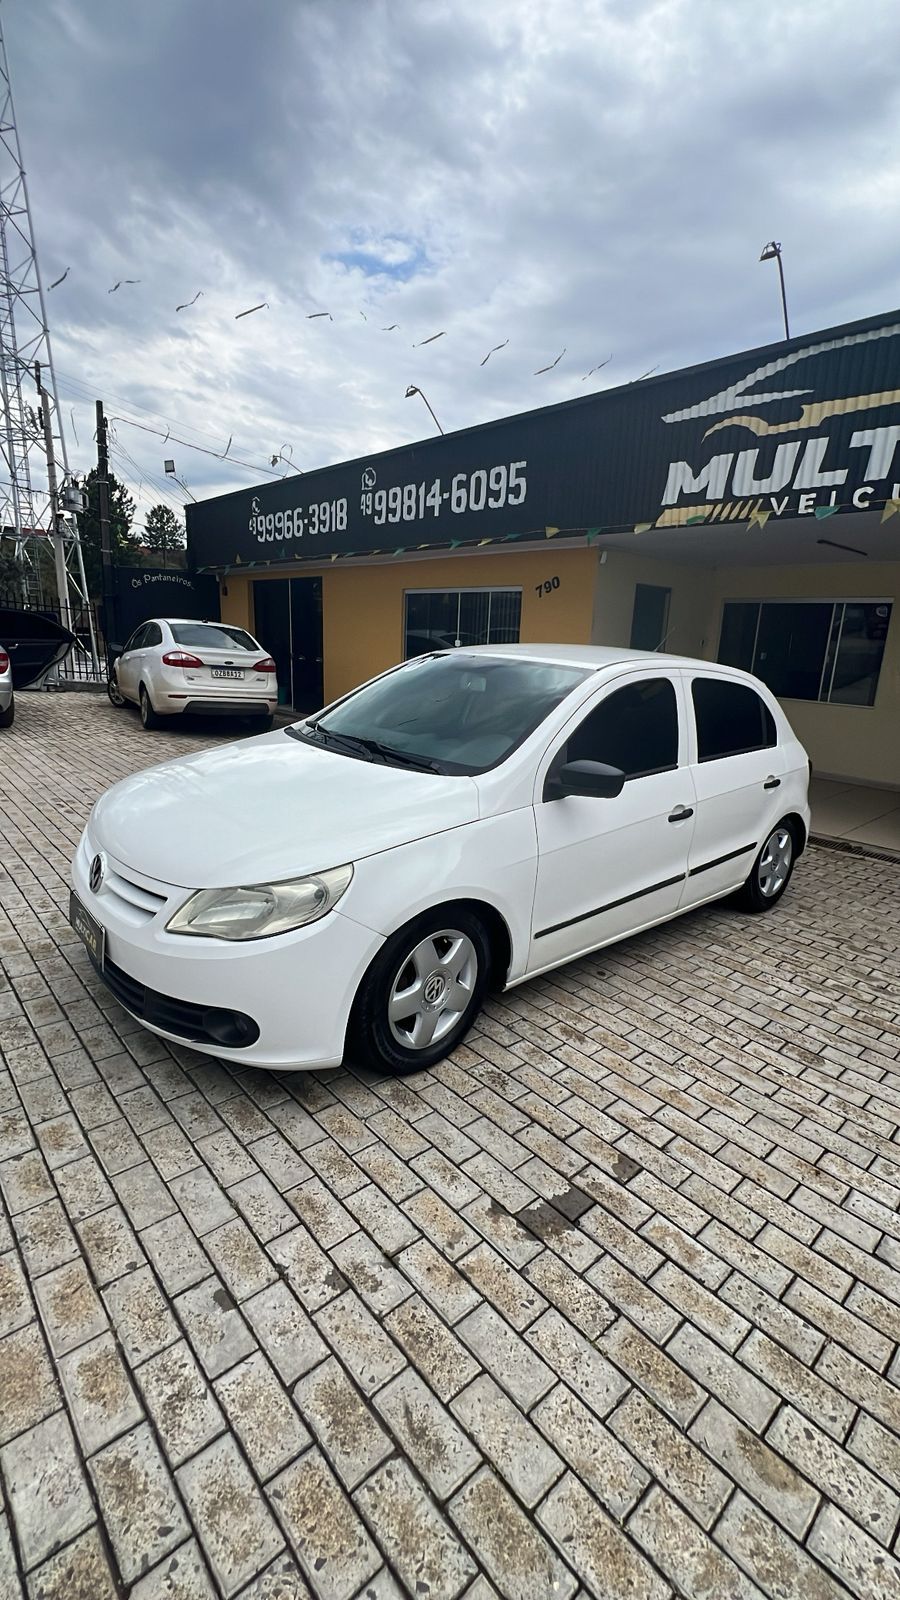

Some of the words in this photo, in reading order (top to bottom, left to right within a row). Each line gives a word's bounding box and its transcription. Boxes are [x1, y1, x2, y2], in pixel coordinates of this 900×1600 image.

[360, 492, 373, 516] 49
[374, 460, 528, 525] 99814-6095
[257, 497, 348, 543] 99966-3918
[535, 576, 560, 598] 790
